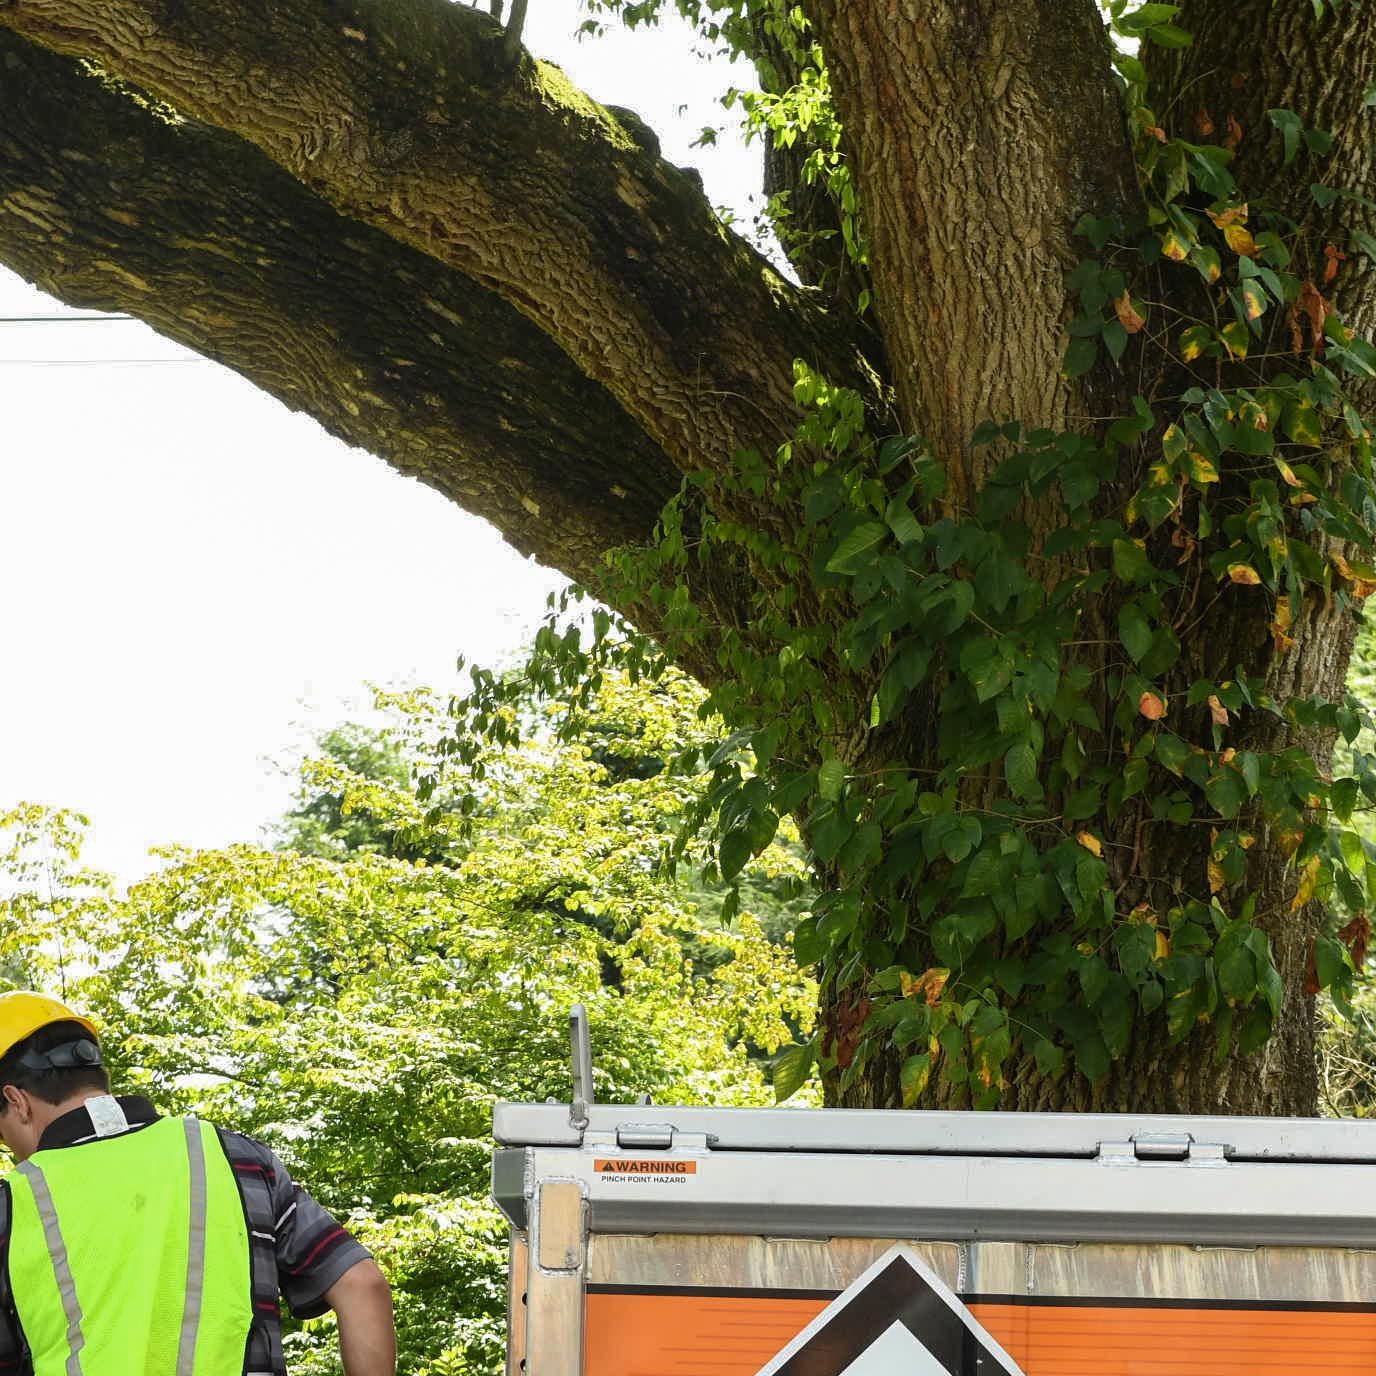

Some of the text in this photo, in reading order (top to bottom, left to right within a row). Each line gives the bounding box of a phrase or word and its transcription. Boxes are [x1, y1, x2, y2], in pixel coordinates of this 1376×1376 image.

[616, 1161, 686, 1173] WARNING
[601, 1175, 686, 1184] PINCH POINT HAZARD
